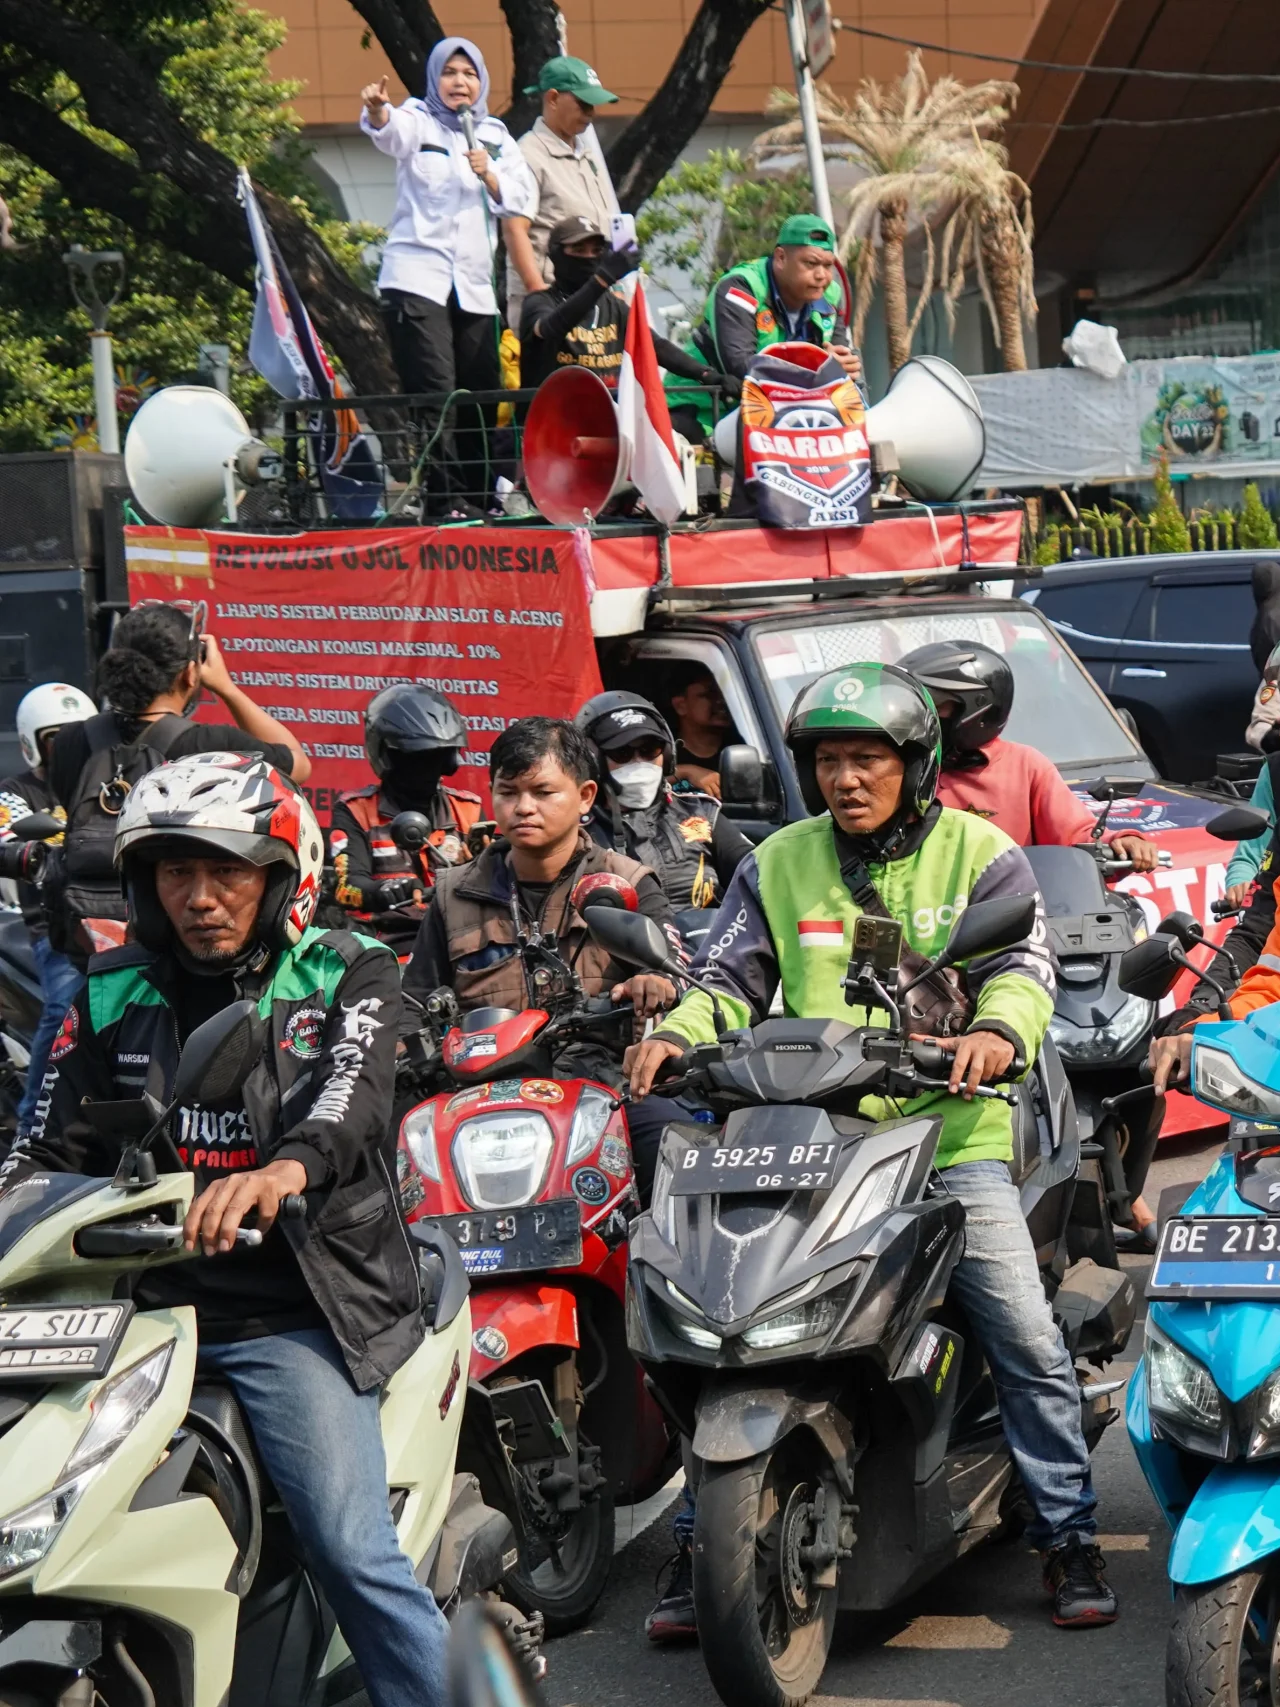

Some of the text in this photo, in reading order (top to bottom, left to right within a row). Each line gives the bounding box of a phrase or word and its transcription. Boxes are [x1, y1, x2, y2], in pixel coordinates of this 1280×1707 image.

[1172, 423, 1200, 438] DAY
[748, 430, 869, 459] GARDA
[814, 509, 855, 522] AKSI
[215, 544, 335, 571] REVOLUSI
[418, 544, 560, 574] INDONESIA
[216, 604, 564, 628] 1.HAPUS SISTEM PERBUDAKAN SLOT & ACENG
[221, 637, 502, 660] 2.POTONGAN KOMISI MAKSIMAL 10%
[295, 674, 352, 690] SISTEM
[310, 709, 361, 725] SUSUN
[314, 743, 366, 760] REVISI
[774, 1044, 813, 1052] HONDA
[117, 1053, 150, 1064] WARSIDIN
[476, 1097, 525, 1109] HONDA
[682, 1144, 836, 1169] B 5925 BFI
[1169, 1225, 1209, 1253] BE
[43, 1311, 109, 1338] SUT
